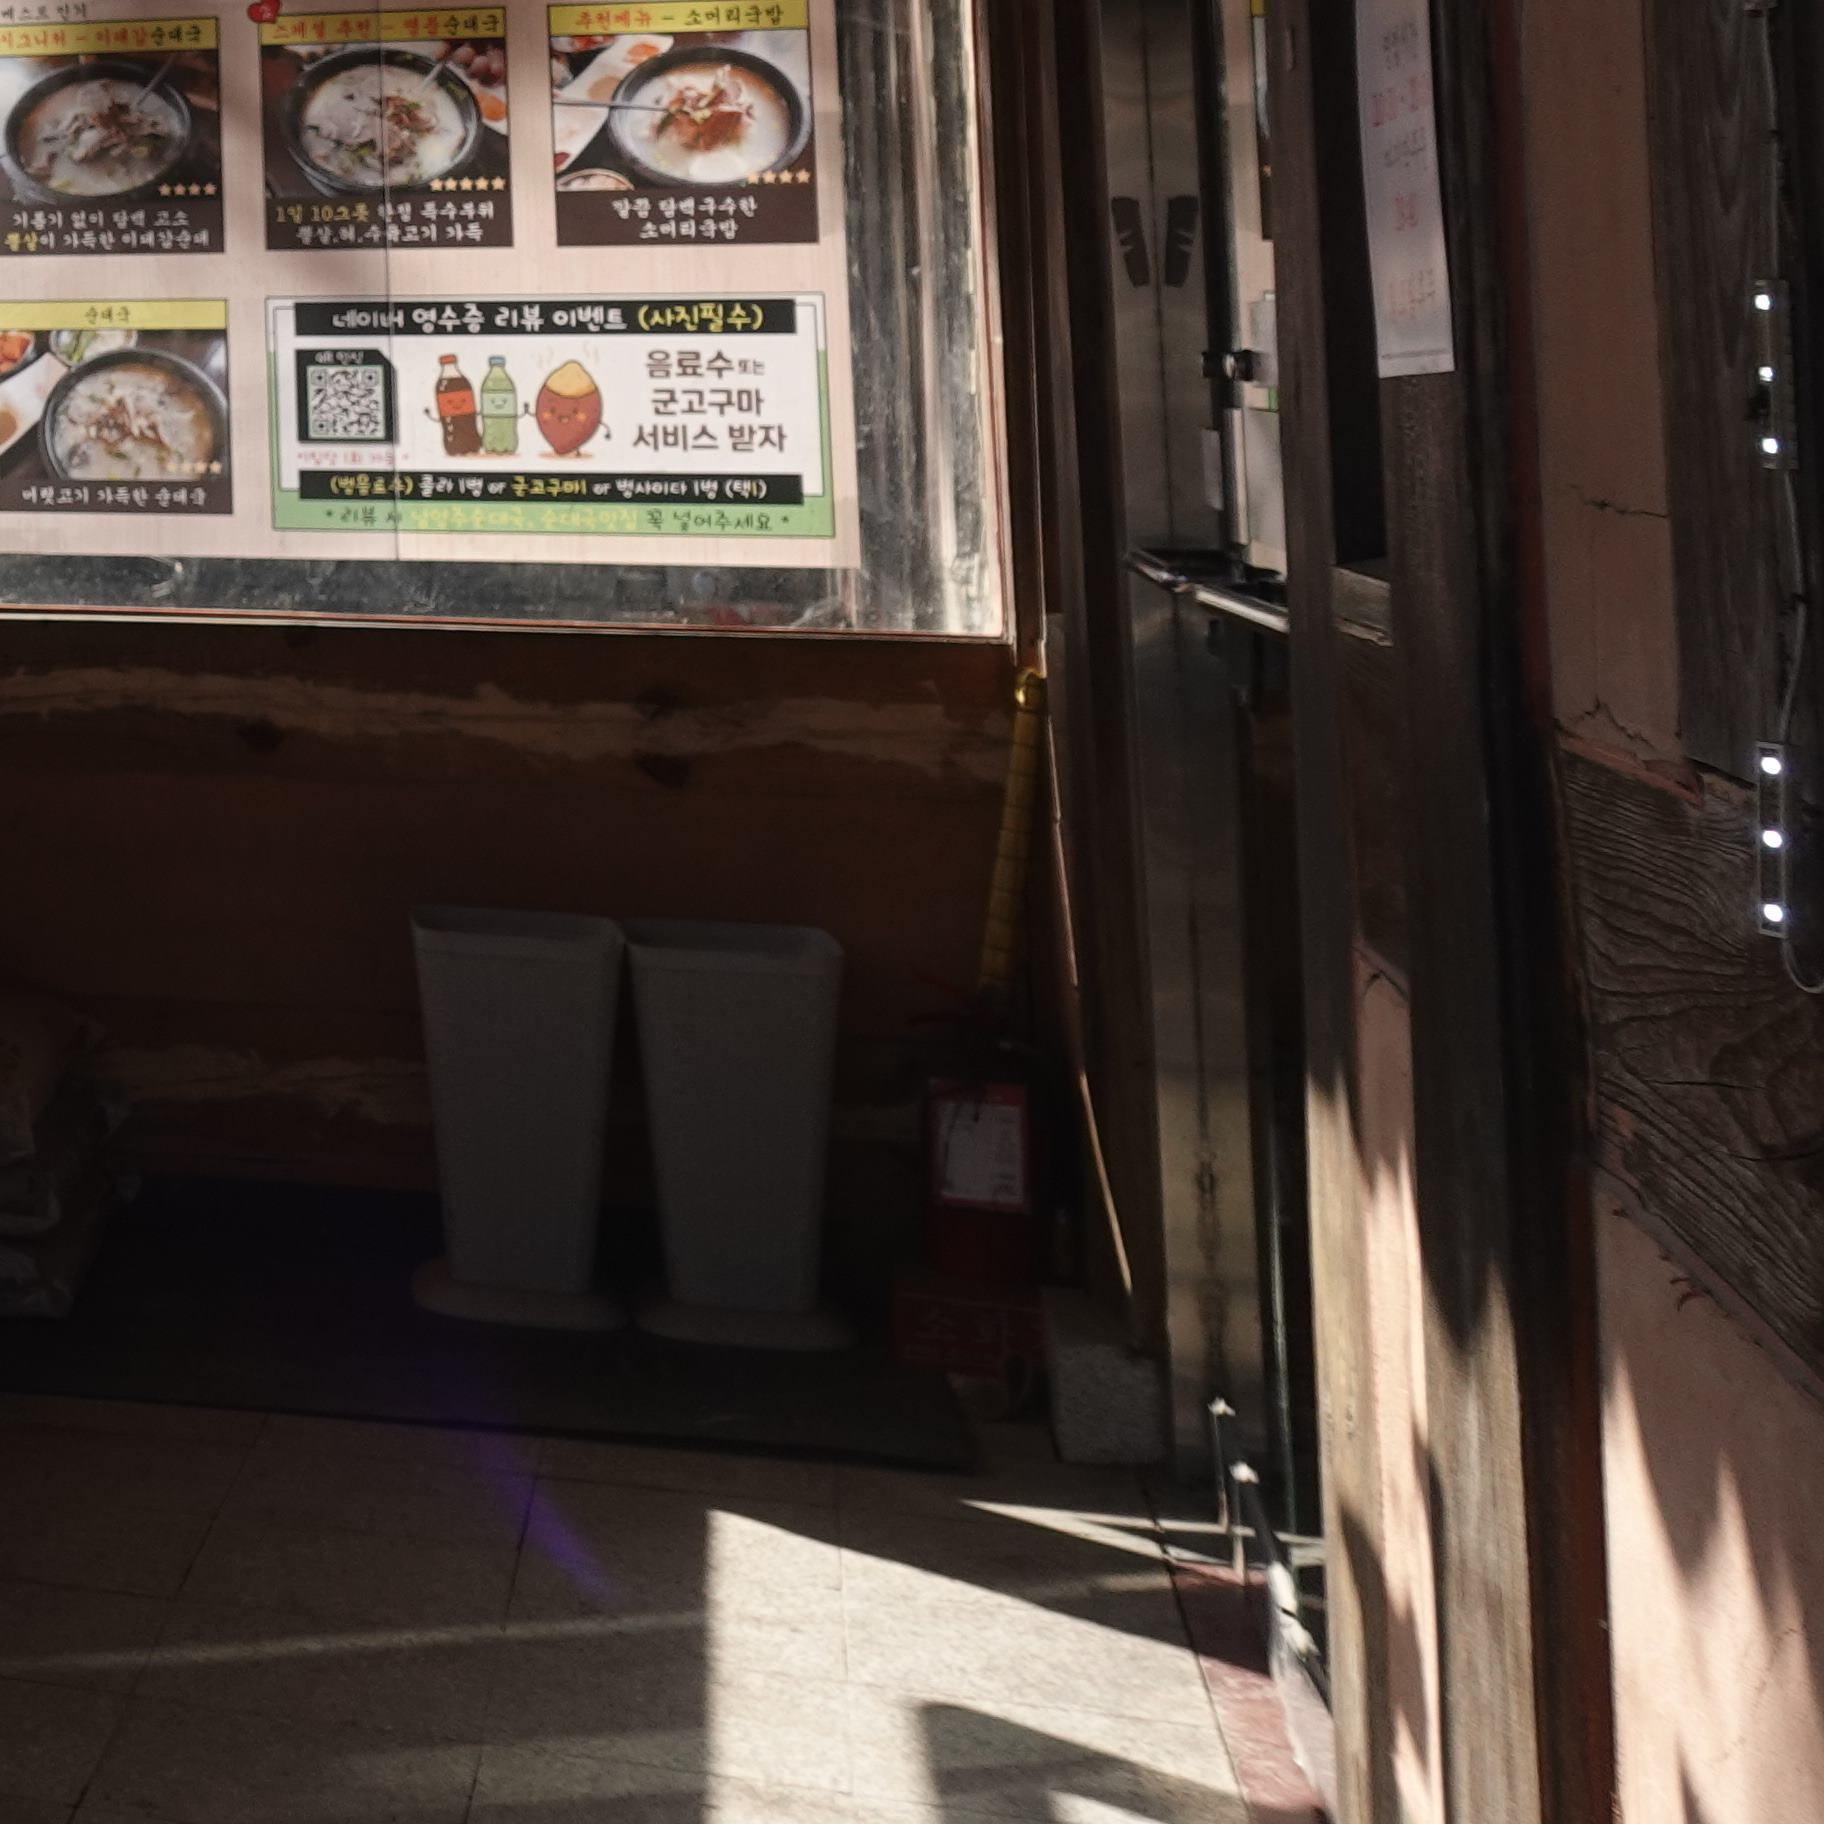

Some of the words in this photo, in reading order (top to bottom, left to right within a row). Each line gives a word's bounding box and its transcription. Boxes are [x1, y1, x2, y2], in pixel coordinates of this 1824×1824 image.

[575, 9, 652, 31] 추천메뉴
[684, 4, 784, 27] 소머리국밥
[96, 24, 201, 48] 이대감순대국
[153, 210, 190, 227] 고소
[639, 218, 738, 240] 소머리국밥
[63, 230, 116, 251] 가득한
[445, 222, 484, 242] 가득
[84, 306, 130, 325] 순대국
[332, 310, 405, 329] 네이버
[411, 303, 484, 335] 영수증
[494, 305, 544, 333] 리뷰
[552, 306, 626, 331] 이벤트
[637, 303, 764, 332] (사진필수)
[645, 349, 735, 379] 음료수
[738, 358, 765, 376] 또는
[651, 387, 765, 417] 군고구마
[632, 424, 720, 452] 서비스
[728, 424, 788, 453] 받자
[96, 486, 149, 508] 가득한
[154, 486, 207, 508] 순대국
[418, 474, 455, 498] 콜라
[646, 508, 664, 531] 꼭
